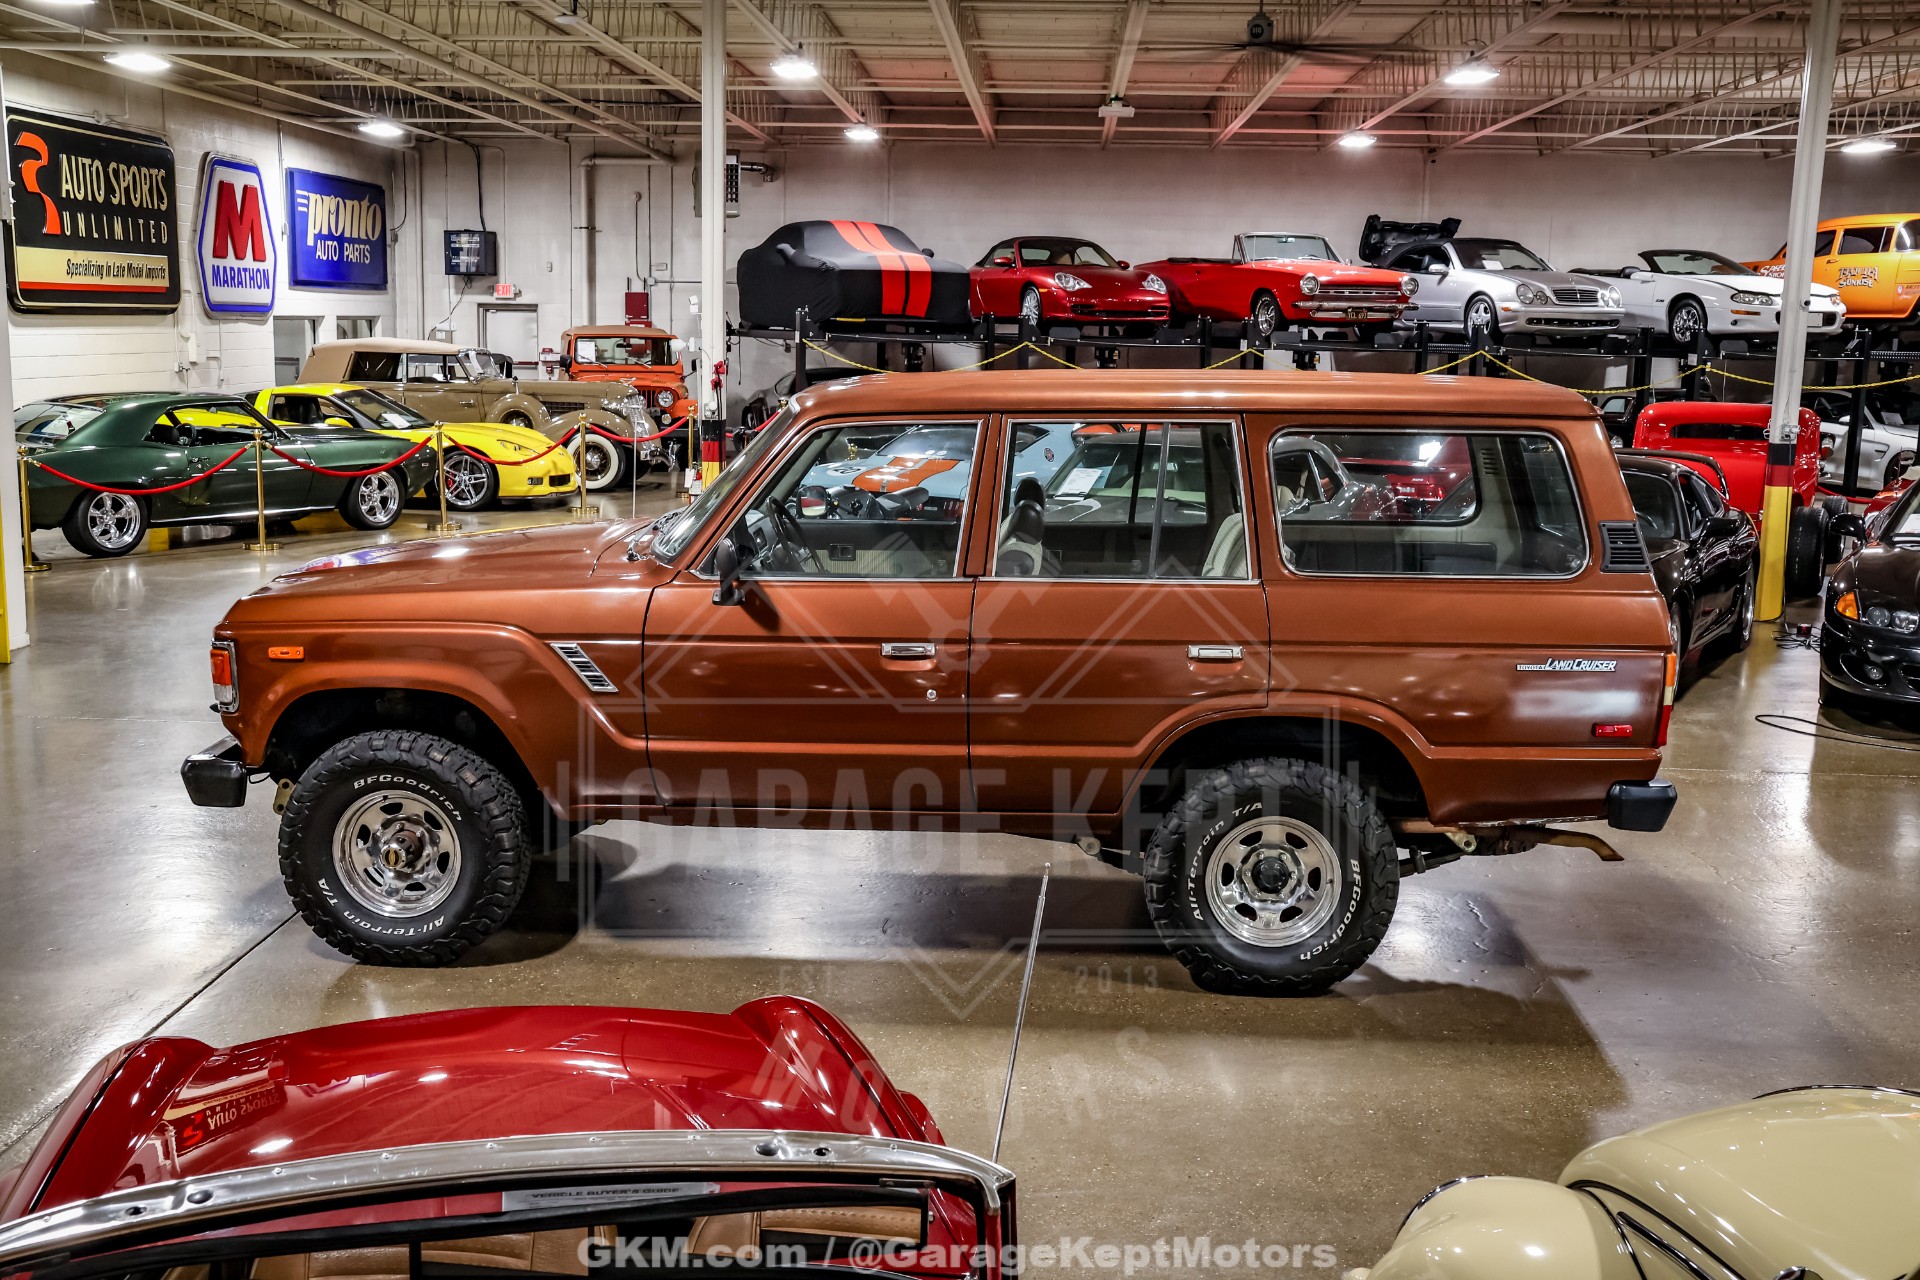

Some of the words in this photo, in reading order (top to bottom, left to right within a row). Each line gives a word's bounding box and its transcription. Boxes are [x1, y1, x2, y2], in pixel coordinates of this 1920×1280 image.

[60, 153, 105, 204] AUTO
[108, 161, 169, 212] SPORTS
[61, 211, 168, 245] UNLIMITED
[212, 180, 267, 263] M
[305, 193, 382, 247] pronto
[315, 240, 339, 261] AUTO
[343, 243, 371, 264] PARTS
[66, 258, 104, 280] Specializing
[105, 260, 112, 277] In
[113, 261, 126, 278] Late
[127, 260, 144, 279] Model
[144, 263, 166, 281] Imports
[211, 264, 270, 290] MARATHON
[496, 284, 511, 296] EXIT
[1545, 658, 1574, 671] LAND
[1573, 658, 1617, 671] CRUISER
[353, 774, 462, 822] BFGoodrich
[1187, 820, 1225, 922] All-Terrain
[1231, 801, 1263, 818] T/A
[317, 877, 340, 907] T/A
[343, 909, 446, 937] All-Terrain
[1300, 859, 1362, 961] BFGoodrich
